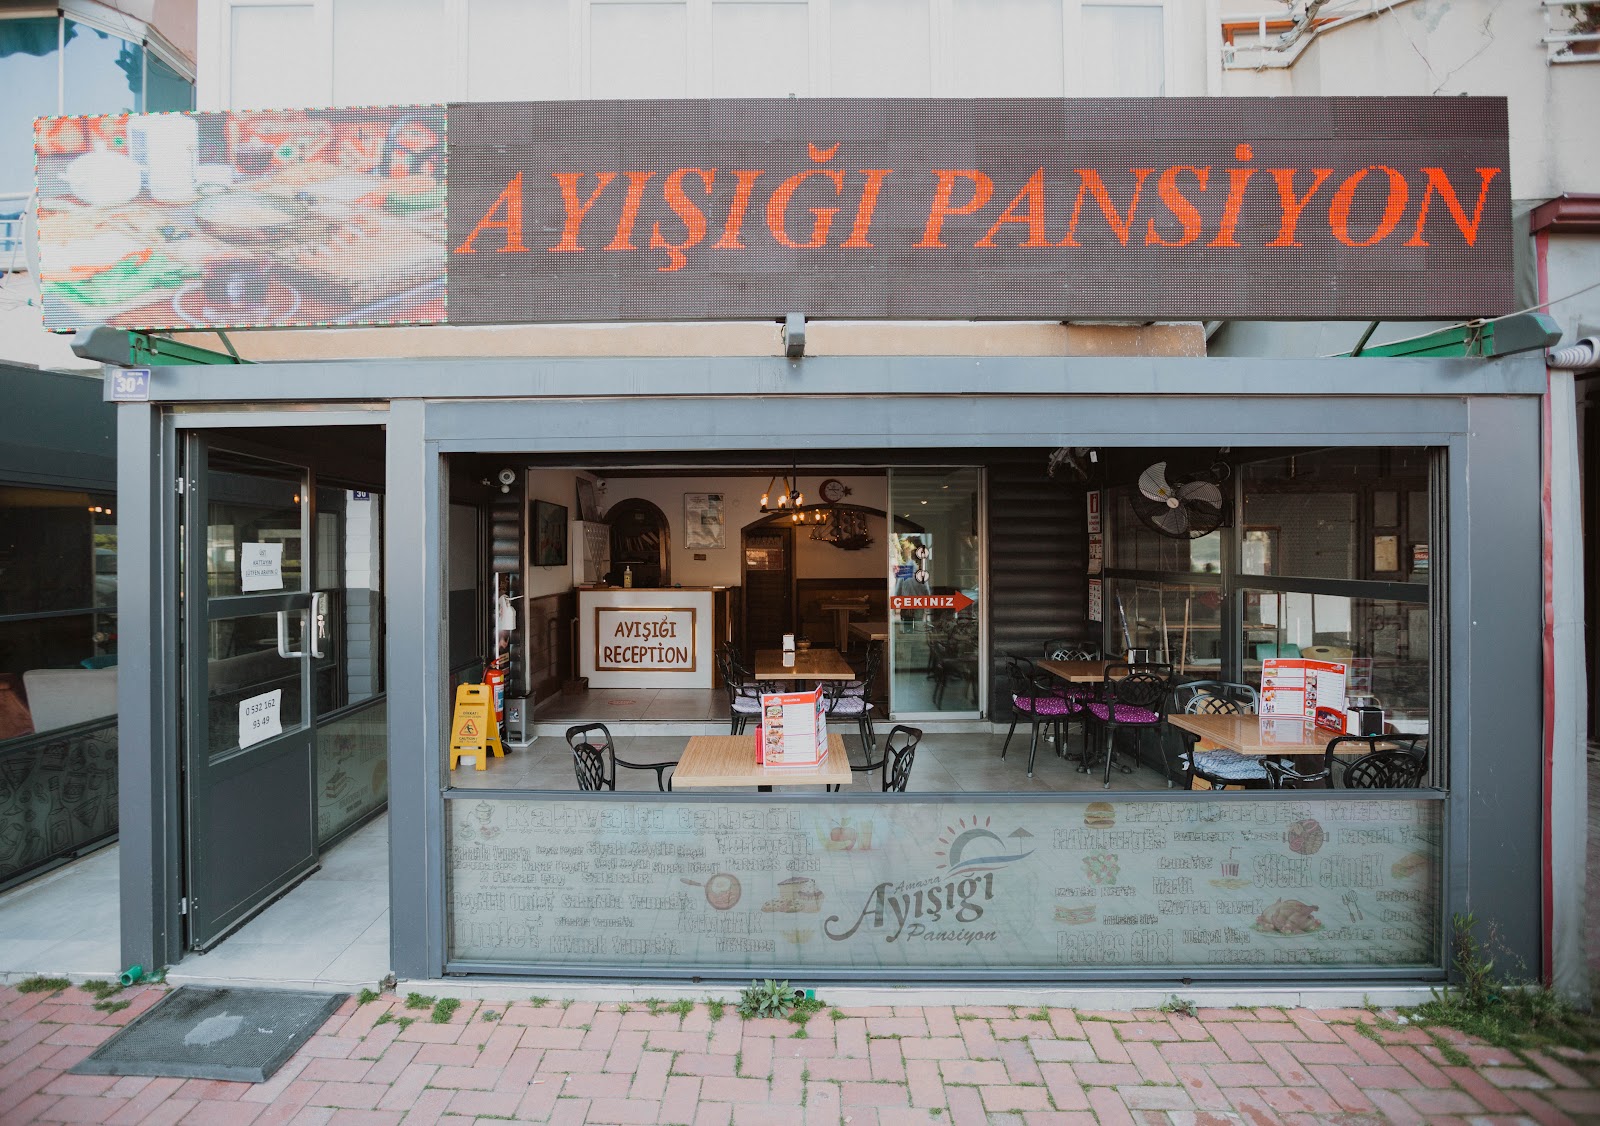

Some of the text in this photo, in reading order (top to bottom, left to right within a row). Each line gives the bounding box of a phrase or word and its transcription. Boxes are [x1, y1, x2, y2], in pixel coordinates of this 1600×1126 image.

[453, 142, 1501, 271] AYIŞIĞI PANSİYON
[245, 698, 276, 716] 0 532 162
[252, 715, 270, 730] 93 49
[894, 876, 942, 894] Amasra
[824, 872, 994, 943] Ayışığı
[906, 923, 997, 945] Pansiyon
